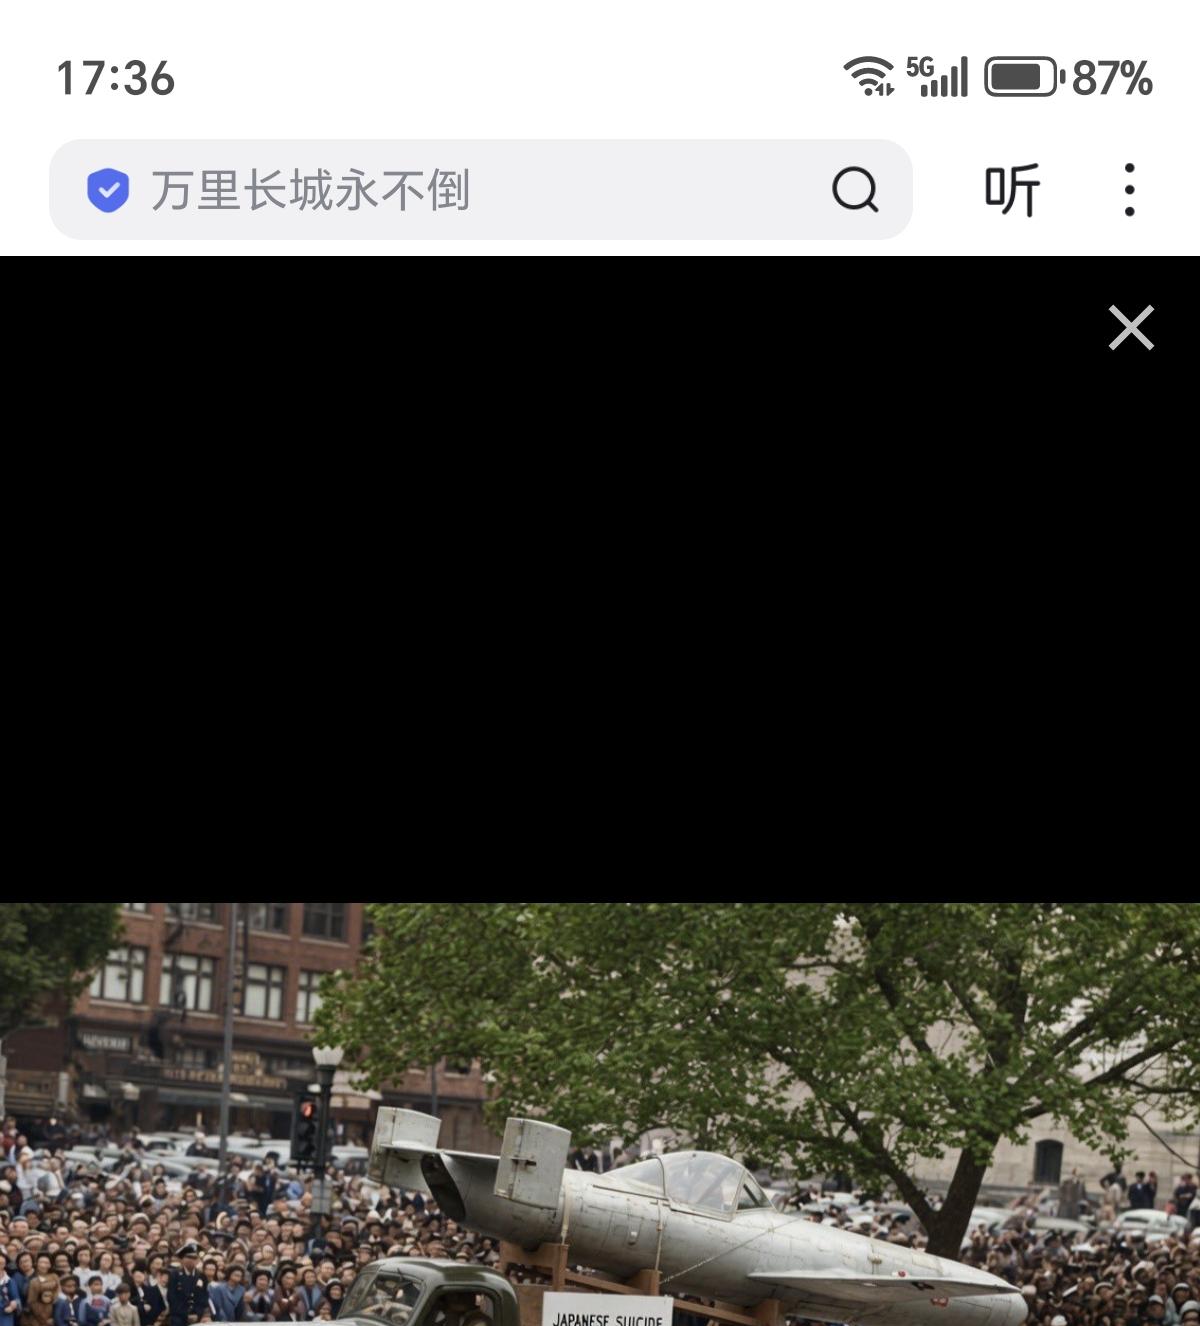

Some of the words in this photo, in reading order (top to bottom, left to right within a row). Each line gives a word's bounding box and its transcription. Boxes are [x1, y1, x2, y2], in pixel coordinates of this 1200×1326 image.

[57, 60, 175, 96] 17:36
[906, 56, 935, 78] 5G
[1072, 60, 1154, 96] 87%
[152, 167, 469, 212] 万里长城永不倒
[985, 162, 1041, 219] 听
